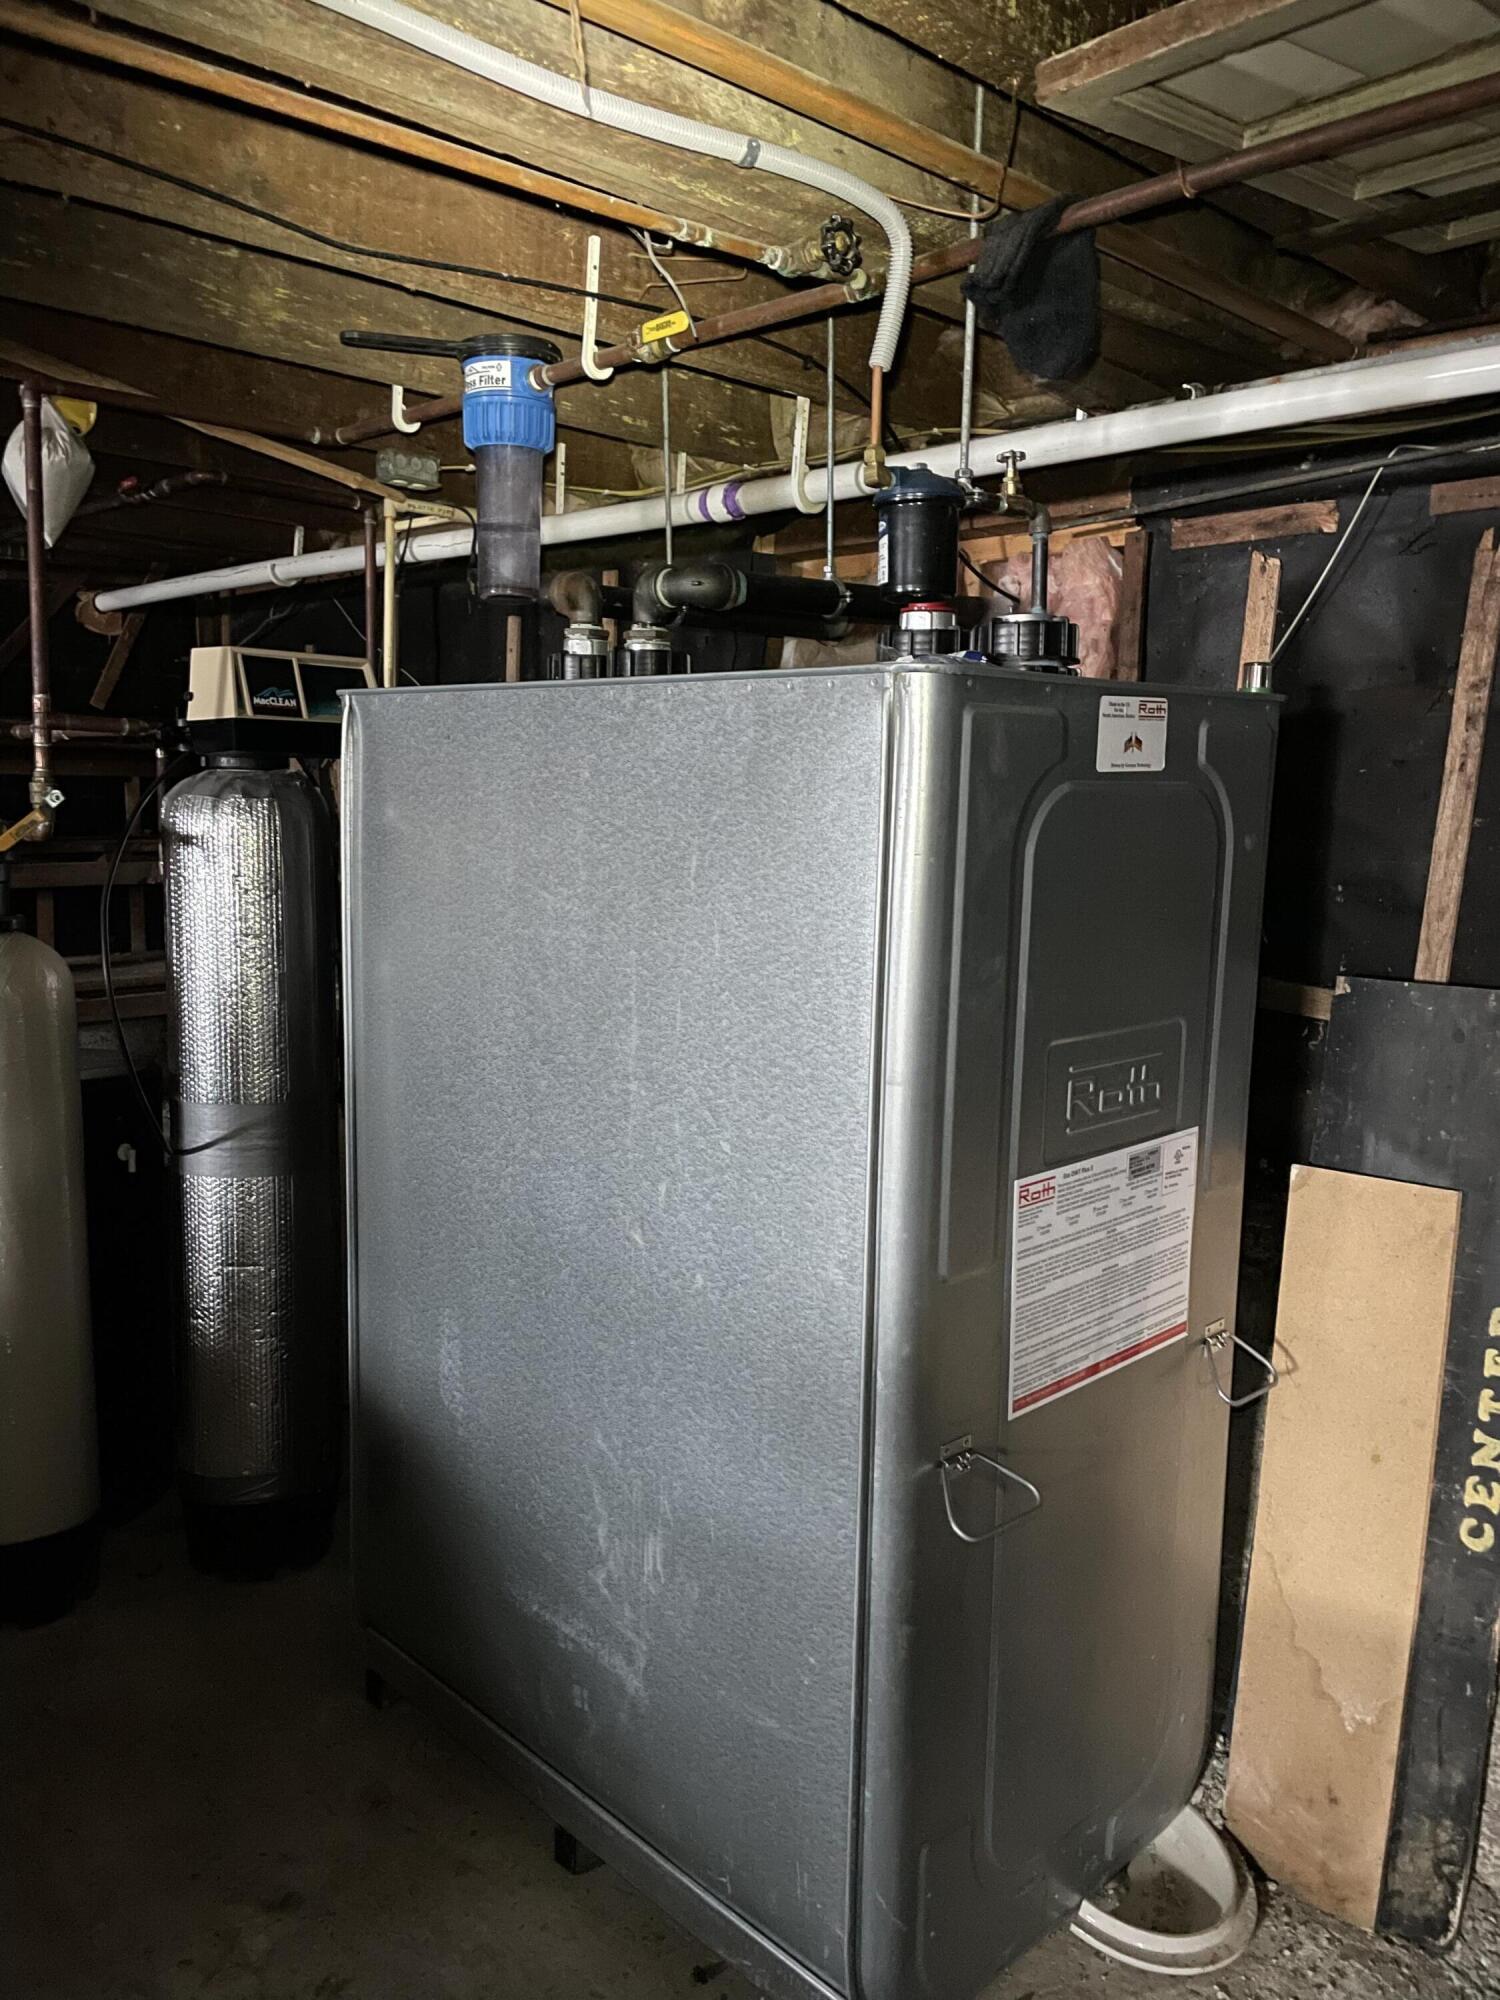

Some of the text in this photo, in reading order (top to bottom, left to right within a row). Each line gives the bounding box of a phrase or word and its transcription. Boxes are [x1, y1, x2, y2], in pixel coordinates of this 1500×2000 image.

[479, 374, 506, 386] Filter
[253, 696, 297, 707] MacCLEAN
[1138, 703, 1167, 715] Roth
[1065, 1064, 1161, 1121] Roth
[1018, 1182, 1056, 1205] Roth
